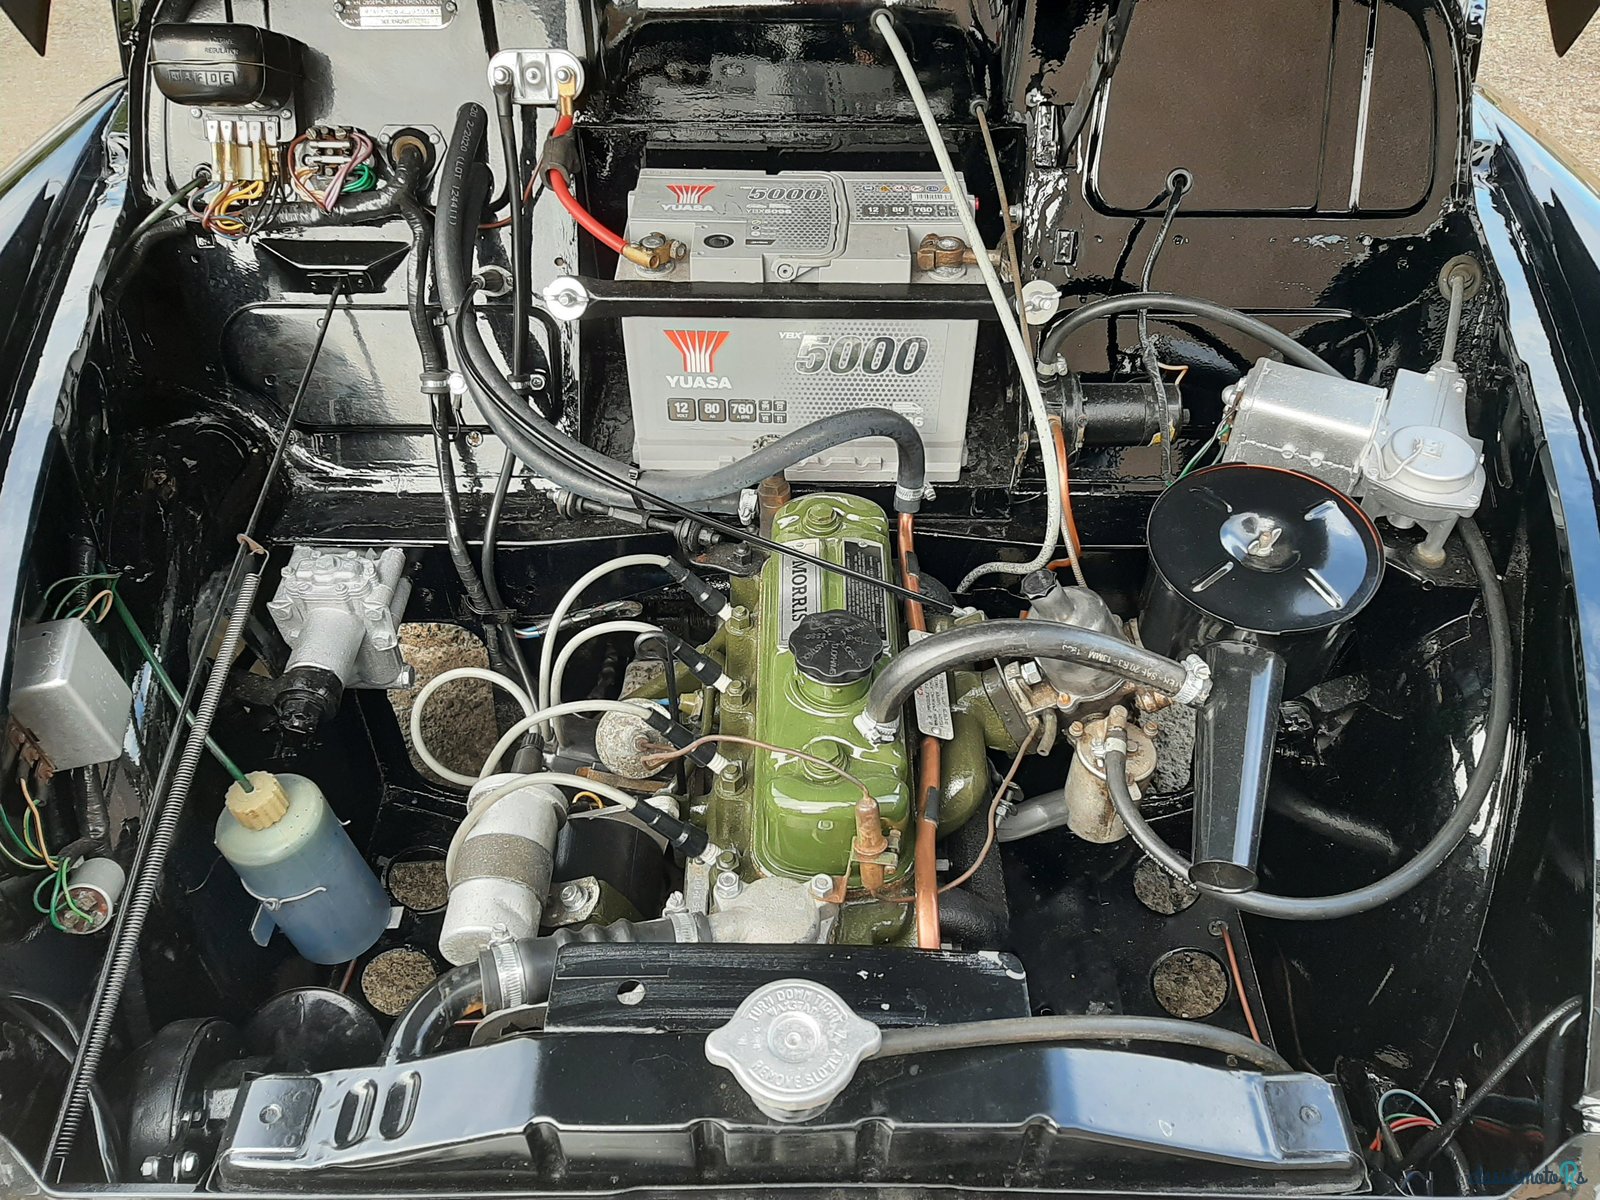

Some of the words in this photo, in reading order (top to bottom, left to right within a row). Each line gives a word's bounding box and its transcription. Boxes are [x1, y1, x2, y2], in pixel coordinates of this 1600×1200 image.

[460, 120, 475, 152] 2/2020
[661, 204, 714, 212] YUASA
[748, 187, 823, 201] 5000
[778, 331, 802, 340] YBX
[794, 335, 930, 376] 5000
[665, 375, 732, 390] YUASA
[674, 401, 689, 413] 12
[704, 402, 720, 414] 80
[730, 403, 754, 415] 760
[791, 560, 808, 622] MORRIS
[749, 994, 775, 1022] TURN
[776, 987, 813, 1001] DOWN
[815, 992, 845, 1025] TIGHT
[751, 1059, 803, 1088] REMOVE
